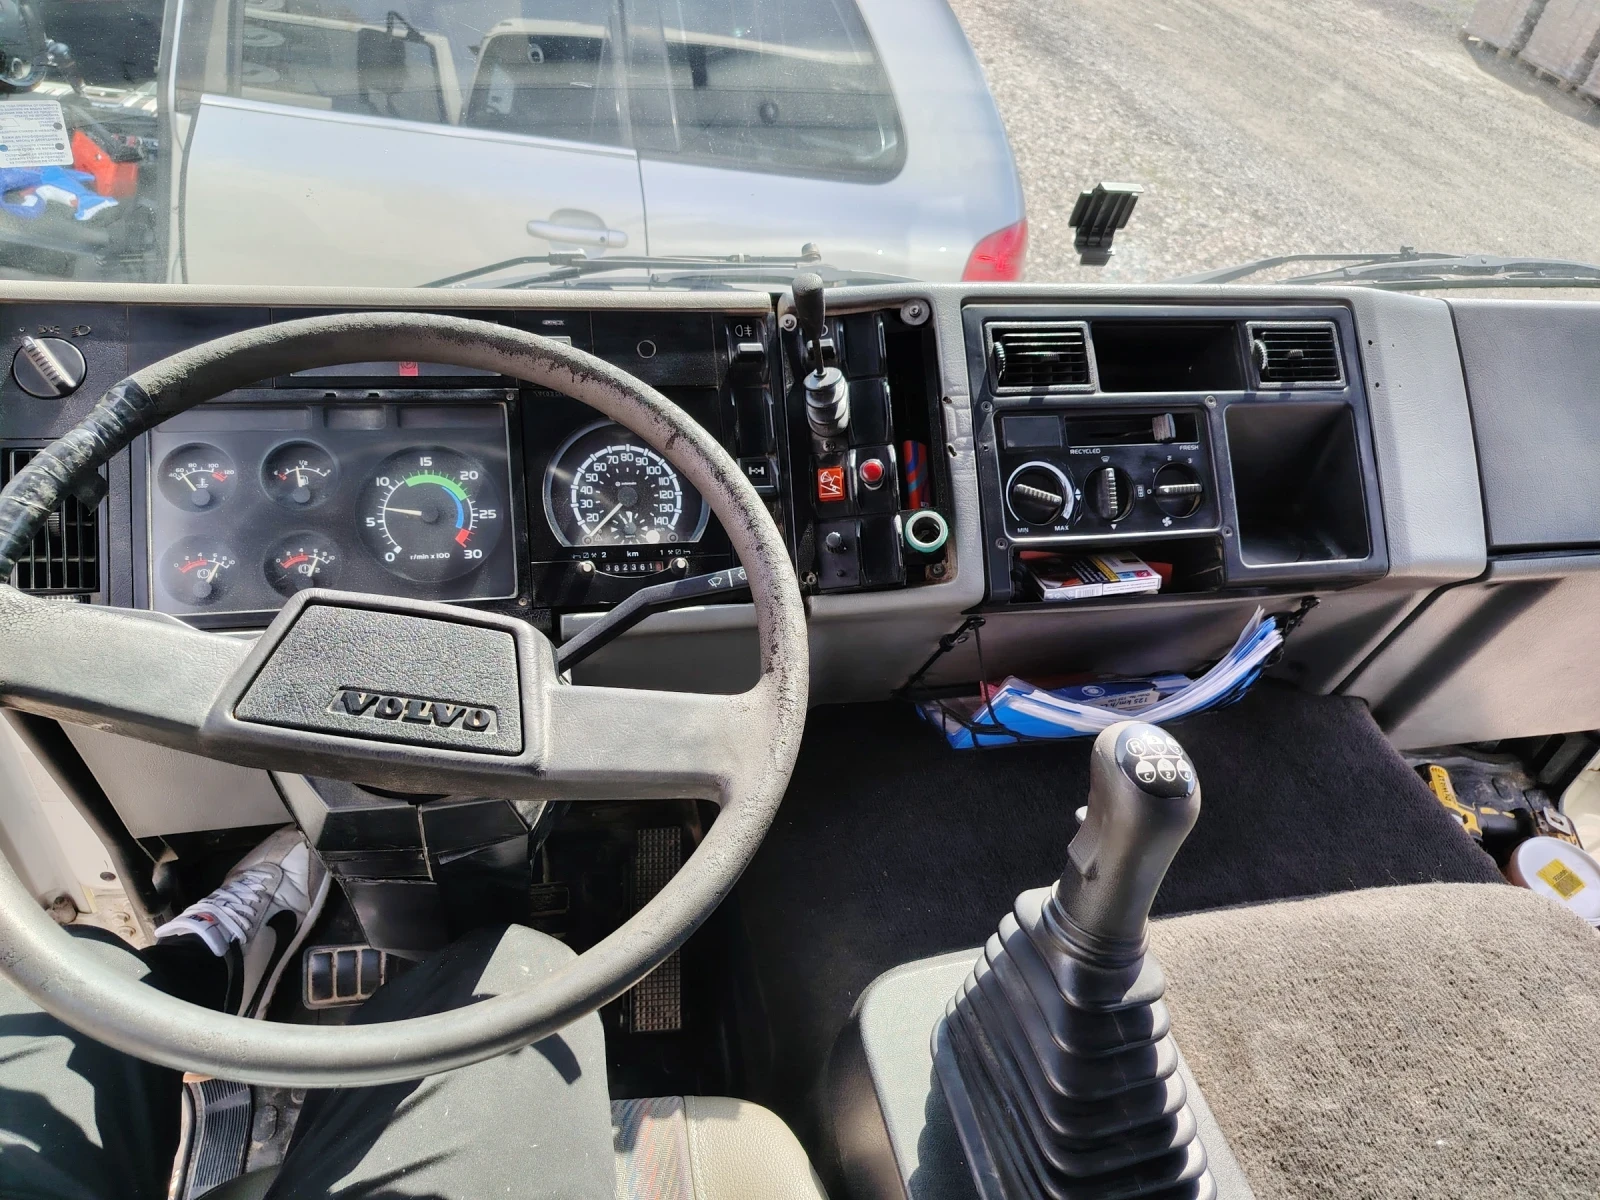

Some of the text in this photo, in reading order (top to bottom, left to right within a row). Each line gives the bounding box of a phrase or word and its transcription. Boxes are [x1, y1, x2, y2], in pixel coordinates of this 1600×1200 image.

[420, 457, 433, 467] 15
[606, 456, 619, 465] 70
[620, 453, 634, 462] 80
[635, 457, 649, 466] 90
[593, 463, 607, 472] 60
[646, 466, 662, 475] 100
[460, 471, 479, 481] 20
[585, 473, 599, 482] 50
[376, 477, 390, 487] 10
[658, 477, 670, 486] 110
[580, 486, 593, 495] 40
[659, 490, 674, 499] 120
[580, 500, 593, 508] 30
[660, 504, 674, 512] 130
[479, 509, 497, 519] 25
[586, 513, 600, 522] 20
[365, 517, 376, 527] 5
[653, 517, 669, 526] 140
[385, 552, 395, 562] 0
[464, 549, 483, 559] 30
[1110, 699, 1132, 708] km/h
[341, 690, 491, 733] VOLVO
[1129, 741, 1143, 754] R
